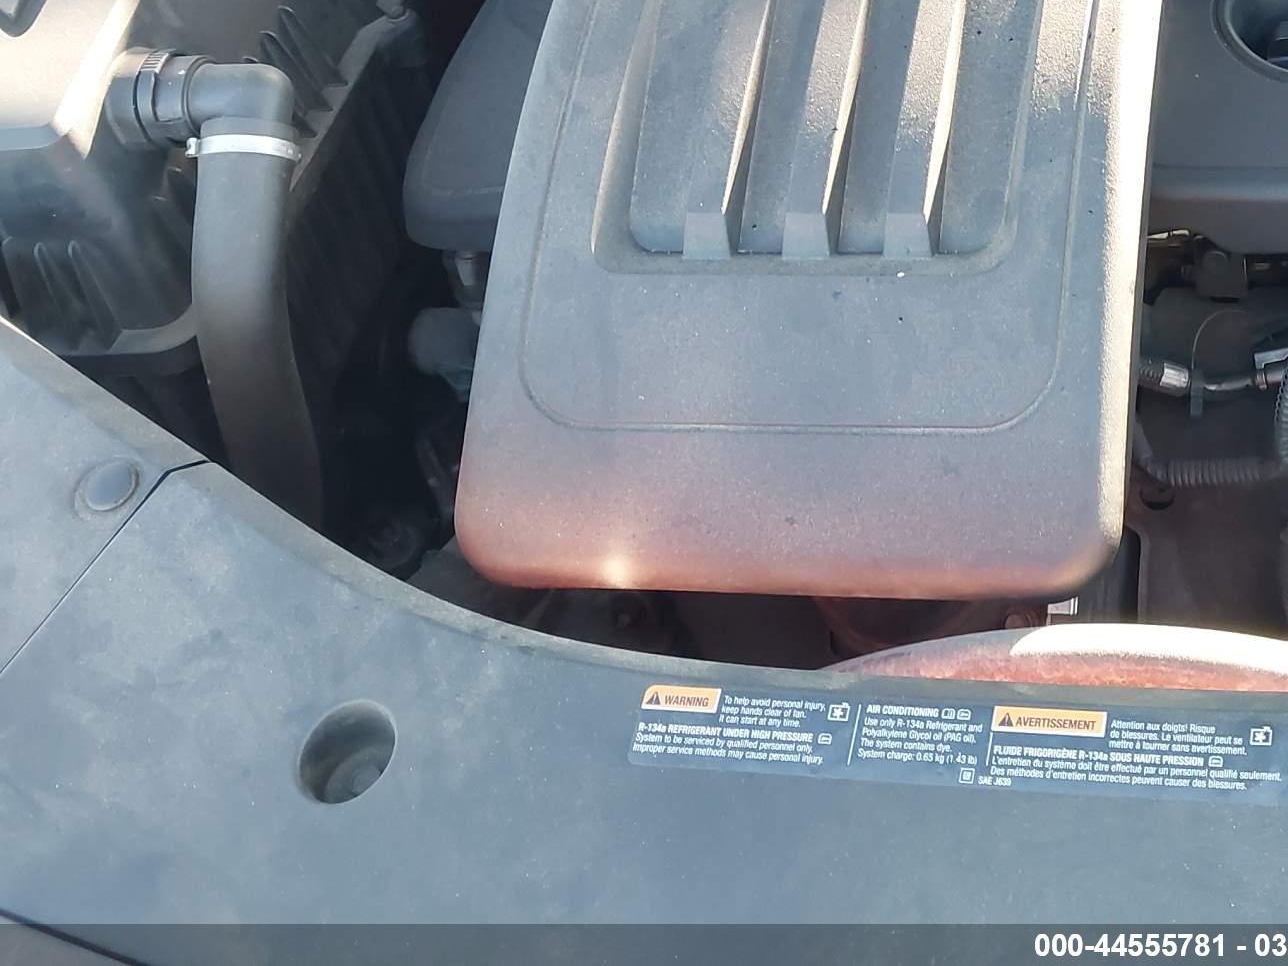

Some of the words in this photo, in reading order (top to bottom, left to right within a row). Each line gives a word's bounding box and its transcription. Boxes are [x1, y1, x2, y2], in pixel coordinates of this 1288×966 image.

[664, 695, 709, 707] WARNING
[724, 695, 732, 704] To
[734, 696, 749, 706] help
[751, 698, 771, 706] avoid
[772, 699, 803, 708] personal
[721, 705, 739, 714] keep
[741, 706, 762, 715] hands
[764, 708, 782, 716] clear
[784, 709, 792, 717] of
[793, 710, 806, 718] fan.
[866, 704, 881, 714] AIR
[882, 705, 939, 717] CONDITIONING
[725, 716, 739, 724] can
[740, 716, 758, 724] start
[768, 719, 781, 727] any
[783, 719, 800, 727] time.
[864, 717, 878, 726] Use
[880, 718, 895, 728] only
[897, 719, 925, 729] R-134a
[926, 721, 966, 732] Refrigerant
[967, 723, 983, 732] and
[1016, 716, 1096, 730] AVERTISSEMENT
[1111, 720, 1144, 730] Attention
[1162, 722, 1187, 733] doigts!
[1189, 723, 1215, 735] Risque
[639, 722, 666, 732] R-134a
[668, 724, 722, 736] REFRIGERANT
[723, 727, 750, 738] UNDER
[751, 729, 770, 739] HIGH
[772, 731, 813, 742] PRESSURE
[862, 727, 907, 739] Polyalkylene
[909, 730, 932, 741] Glycol
[933, 731, 942, 740] oil
[944, 732, 961, 742] (PAG
[1110, 730, 1119, 738] de
[1122, 731, 1159, 741] blessures.
[1161, 733, 1171, 741] Le
[1173, 734, 1213, 743] ventilateur
[1214, 736, 1232, 745] peut
[636, 733, 662, 742] System
[673, 735, 682, 743] be
[684, 737, 714, 746] serviced
[716, 738, 725, 747] by
[727, 739, 758, 749] qualified
[759, 741, 795, 751] personnel
[860, 737, 874, 747] The
[875, 739, 902, 749] system
[904, 741, 935, 751] contains
[936, 743, 952, 753] dye.
[1109, 740, 1133, 749] mettre
[1142, 742, 1170, 751] tourner
[1171, 744, 1190, 752] sans
[1191, 745, 1247, 755] avertissement.
[633, 743, 665, 753] Improper
[667, 745, 693, 754] service
[695, 747, 726, 757] methods
[728, 750, 744, 759] may
[745, 751, 767, 759] cause
[768, 753, 800, 762] personal
[858, 748, 885, 759] System
[887, 750, 915, 762] charge:
[916, 752, 933, 761] 0.65
[935, 754, 944, 764] kg
[967, 755, 977, 765] lb)
[993, 745, 1022, 756] FLUIDE
[1079, 750, 1108, 761] R-134a
[1110, 753, 1132, 762] SOUS
[1133, 754, 1161, 764] HAUTE
[1162, 755, 1204, 766] PRESSION
[1033, 758, 1043, 766] du
[1077, 761, 1092, 770] doit
[1144, 766, 1157, 776] par
[1170, 768, 1208, 777] personnel
[1239, 771, 1282, 781] seulement.
[977, 776, 992, 785] SAE
[990, 766, 1005, 775] Des
[1088, 772, 1130, 783] incorrectes
[1132, 776, 1162, 785] peuvent
[1164, 778, 1190, 786] causer
[1192, 779, 1206, 788] des
[1208, 779, 1247, 790] blessures.
